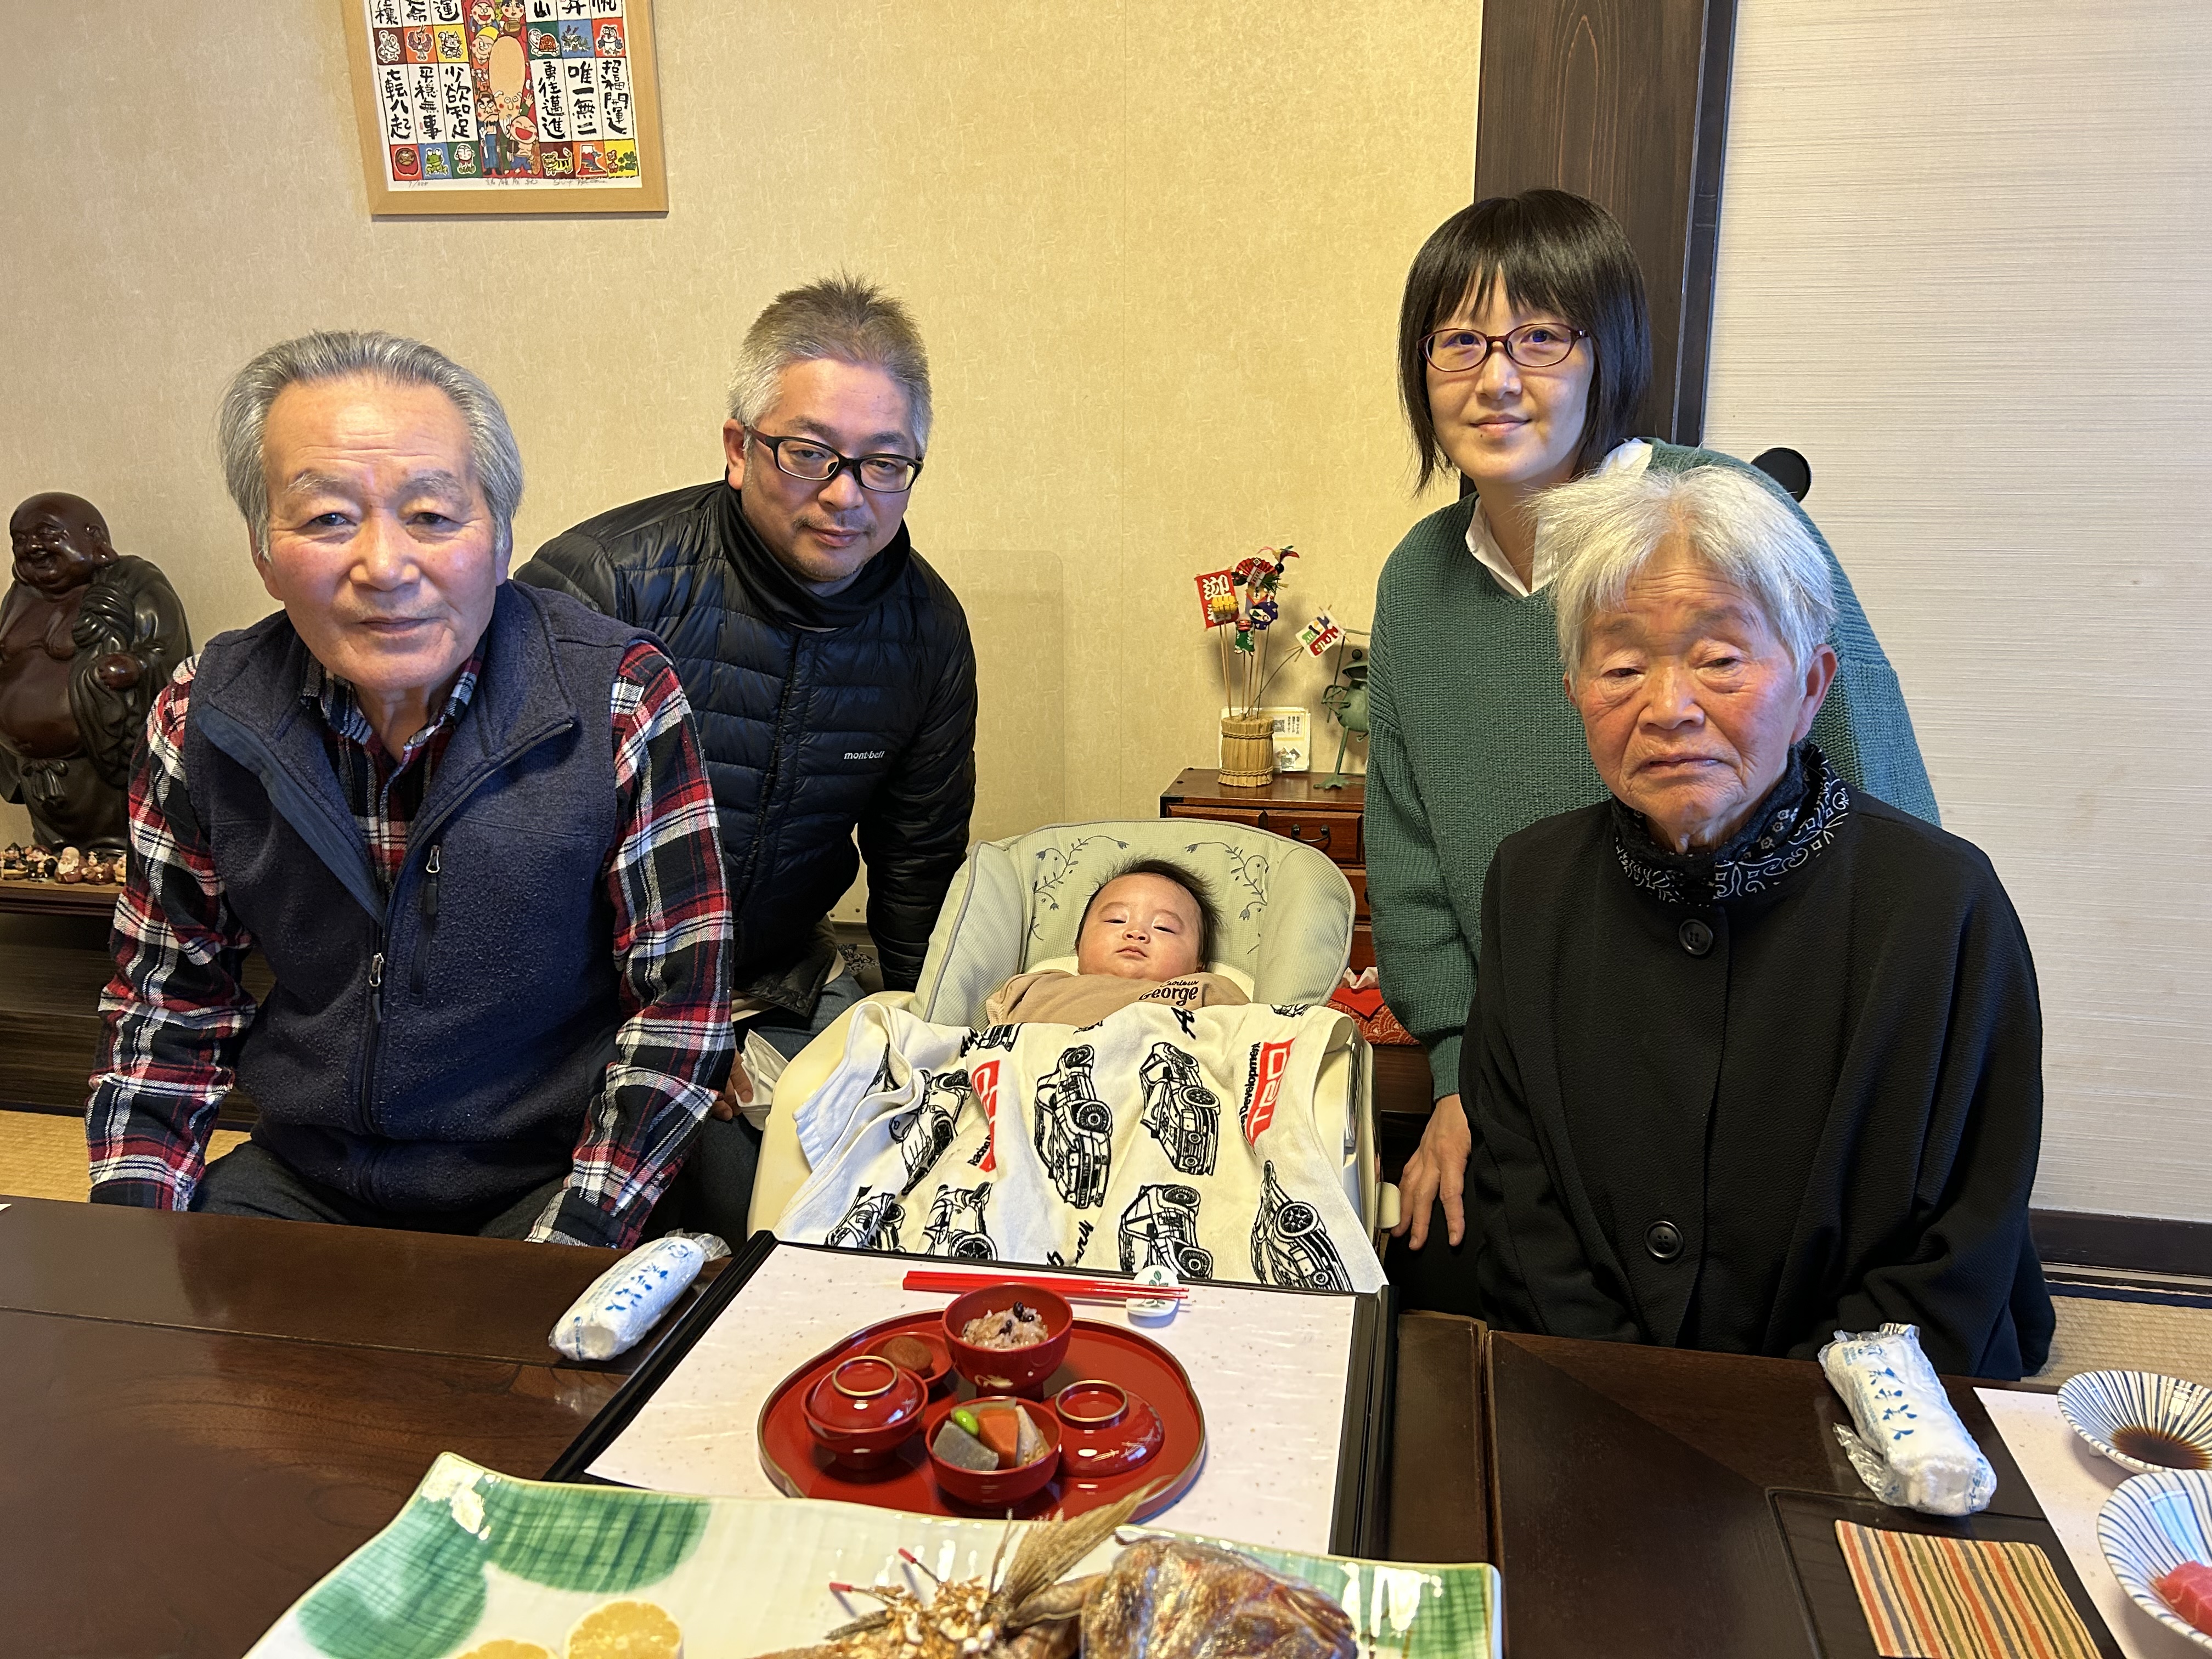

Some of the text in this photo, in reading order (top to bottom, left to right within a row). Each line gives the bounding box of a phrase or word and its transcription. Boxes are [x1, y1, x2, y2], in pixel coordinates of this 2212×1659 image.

[385, 69, 411, 139] 七転八起
[414, 66, 442, 139] 平穏無事
[444, 65, 472, 138] 少欲知足
[538, 61, 566, 139] 勇往邁進
[568, 61, 597, 134] 唯一無二
[601, 60, 629, 134] 招福開運
[1138, 987, 1199, 1006] George
[1160, 979, 1199, 988] Curious
[1239, 1042, 1261, 1116] Development
